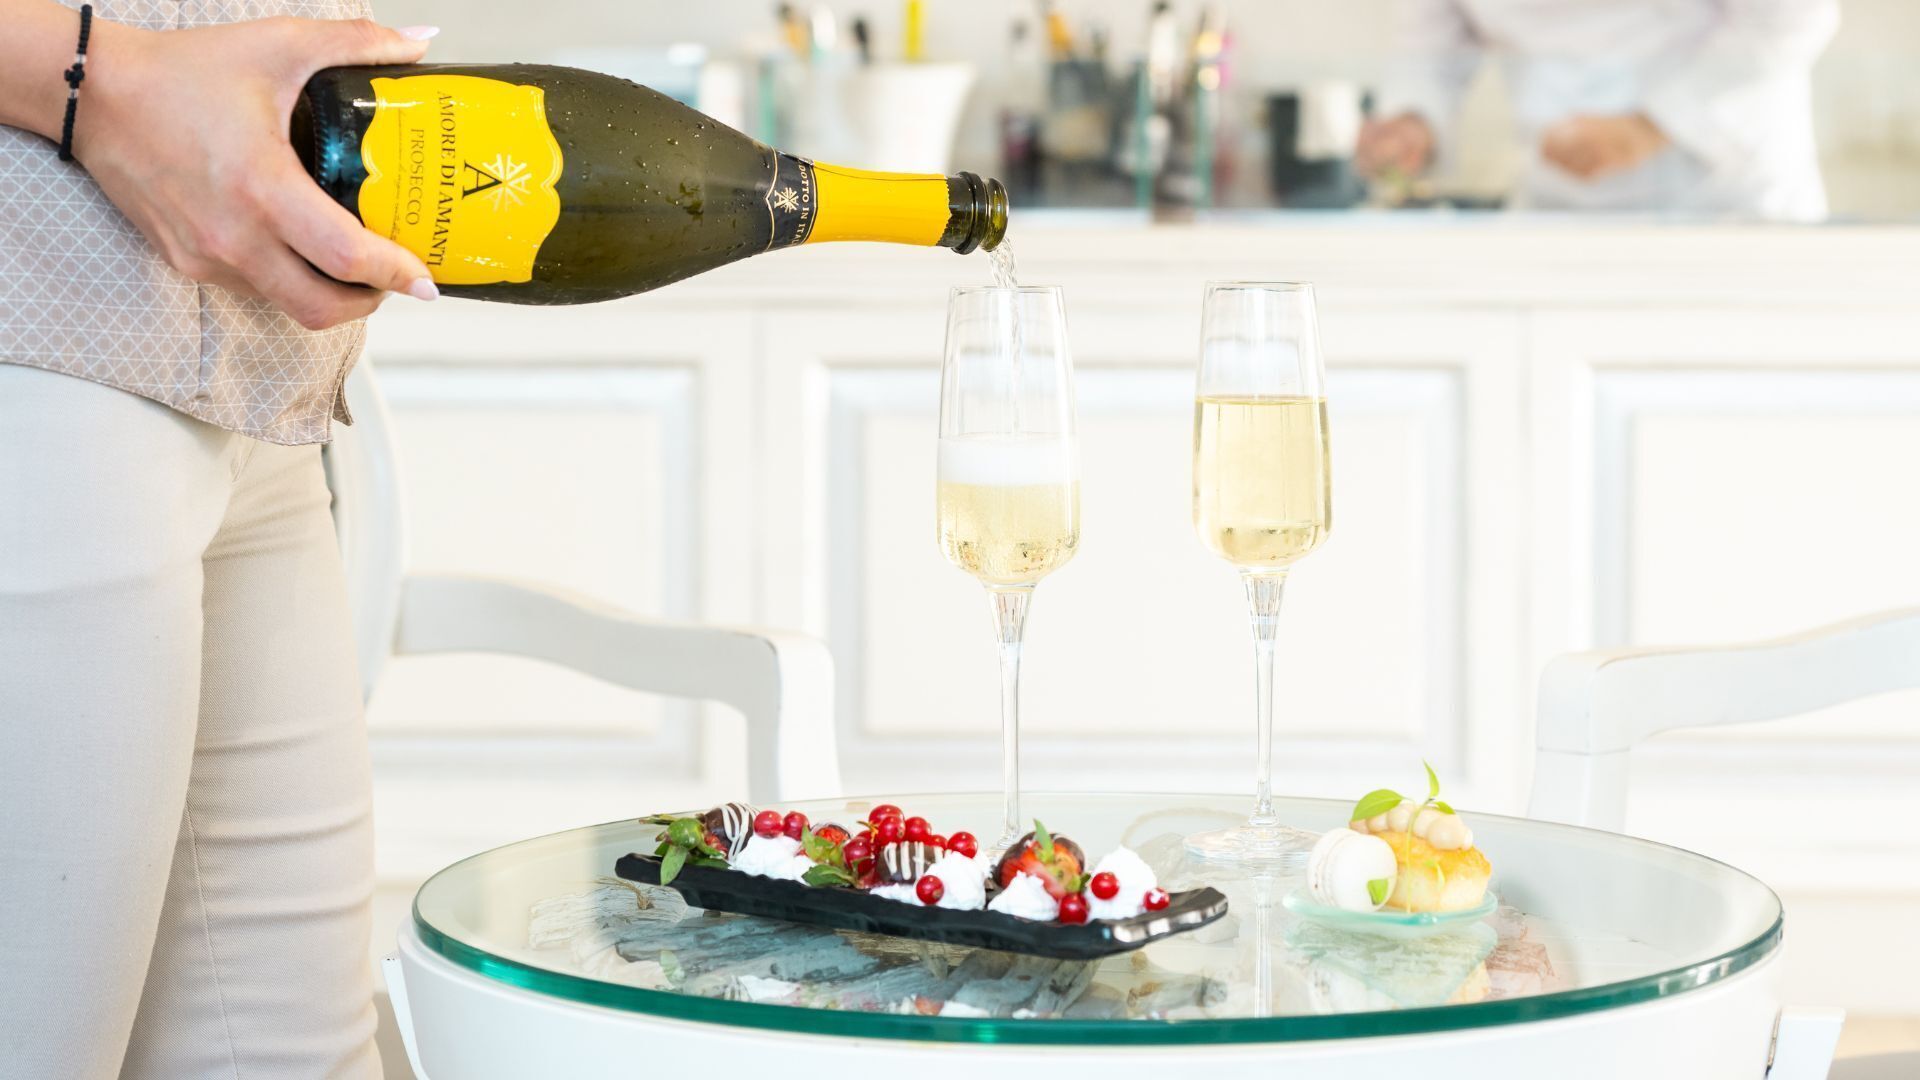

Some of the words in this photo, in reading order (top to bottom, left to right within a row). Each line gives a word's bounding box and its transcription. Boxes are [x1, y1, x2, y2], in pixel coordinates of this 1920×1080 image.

[437, 91, 456, 159] AMORE
[405, 128, 425, 226] PROSECCO
[440, 164, 455, 187] DI
[462, 160, 503, 200] A
[797, 160, 810, 203] DOTTO
[426, 192, 454, 267] AMANTI
[800, 207, 810, 220] IN
